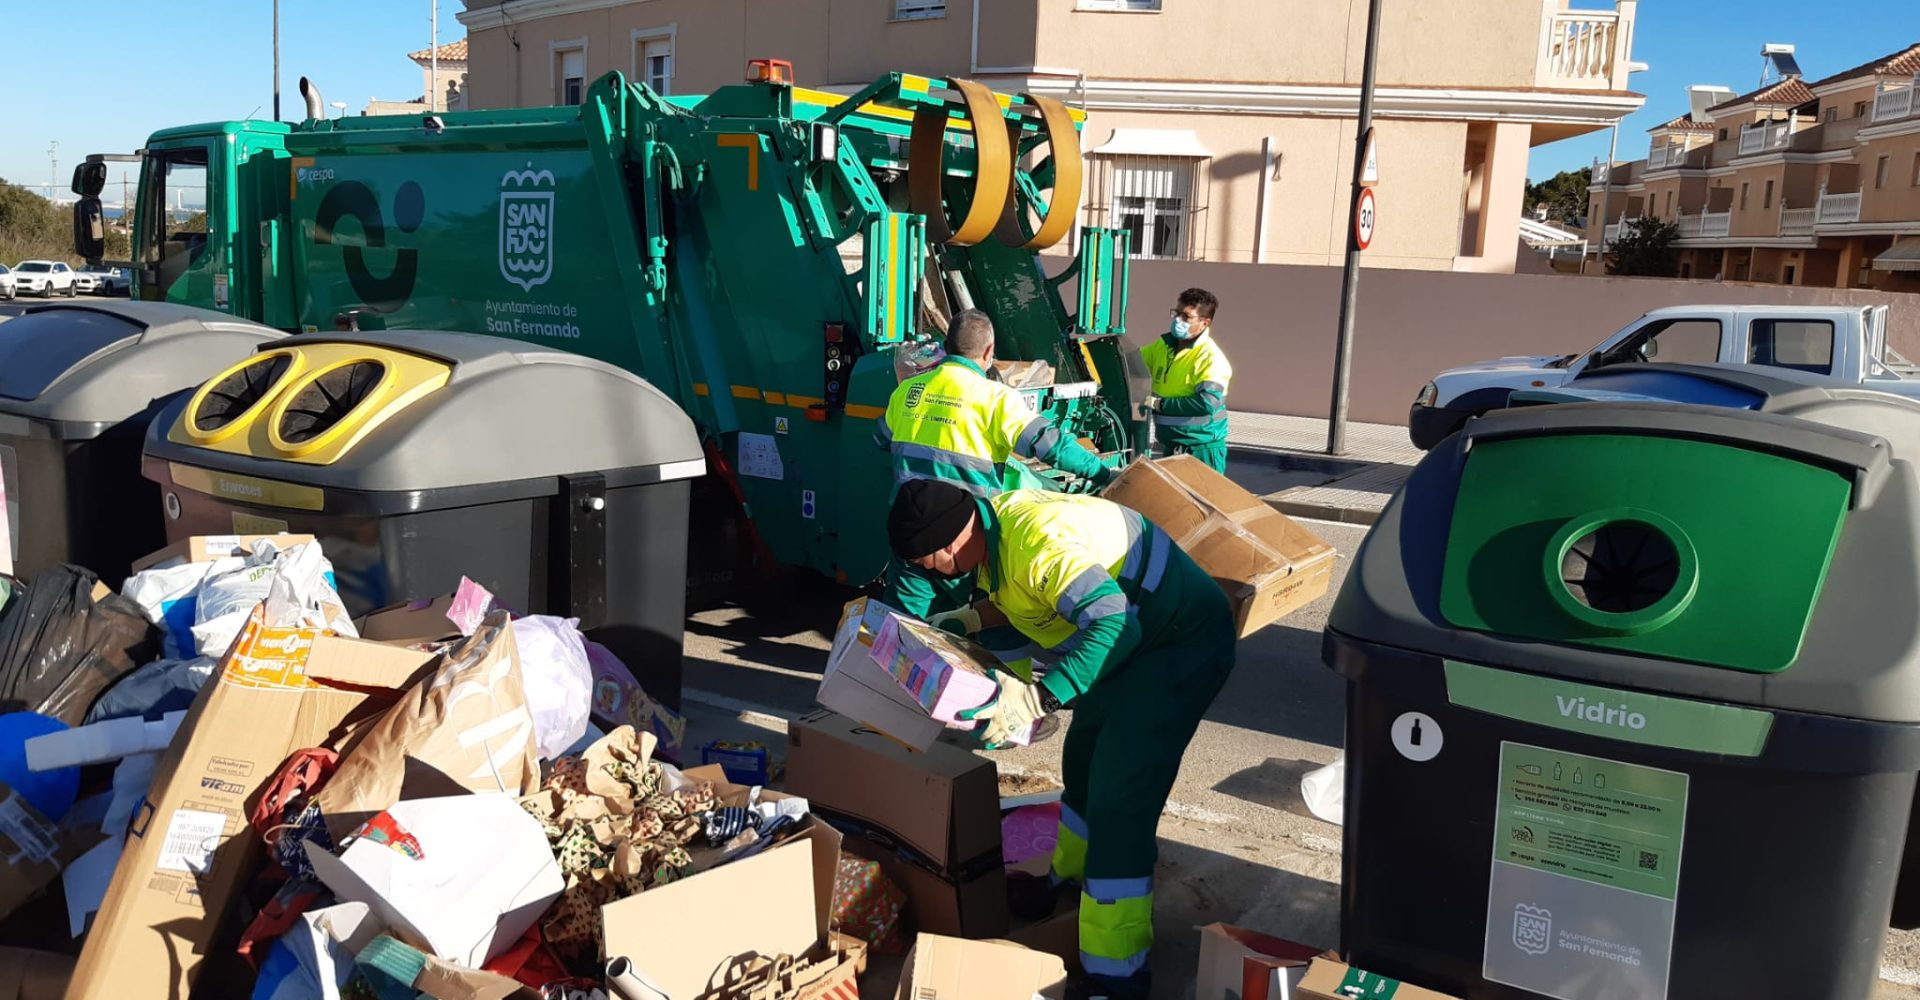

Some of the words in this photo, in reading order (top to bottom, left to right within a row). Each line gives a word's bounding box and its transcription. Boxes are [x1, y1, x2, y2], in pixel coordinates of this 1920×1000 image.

[308, 168, 334, 184] cespa
[507, 203, 546, 227] SAN
[1361, 209, 1372, 229] 30
[485, 299, 561, 317] Ayuntamiento
[563, 303, 577, 317] de
[486, 317, 512, 333] San
[514, 319, 581, 339] Fernando
[219, 479, 263, 498] Envases
[1556, 695, 1646, 729] Vidrio
[1519, 916, 1546, 932] SAN
[1558, 939, 1581, 953] San
[1583, 944, 1641, 966] Fernando
[1559, 929, 1627, 953] Ayuntamiento
[1628, 945, 1641, 955] de
